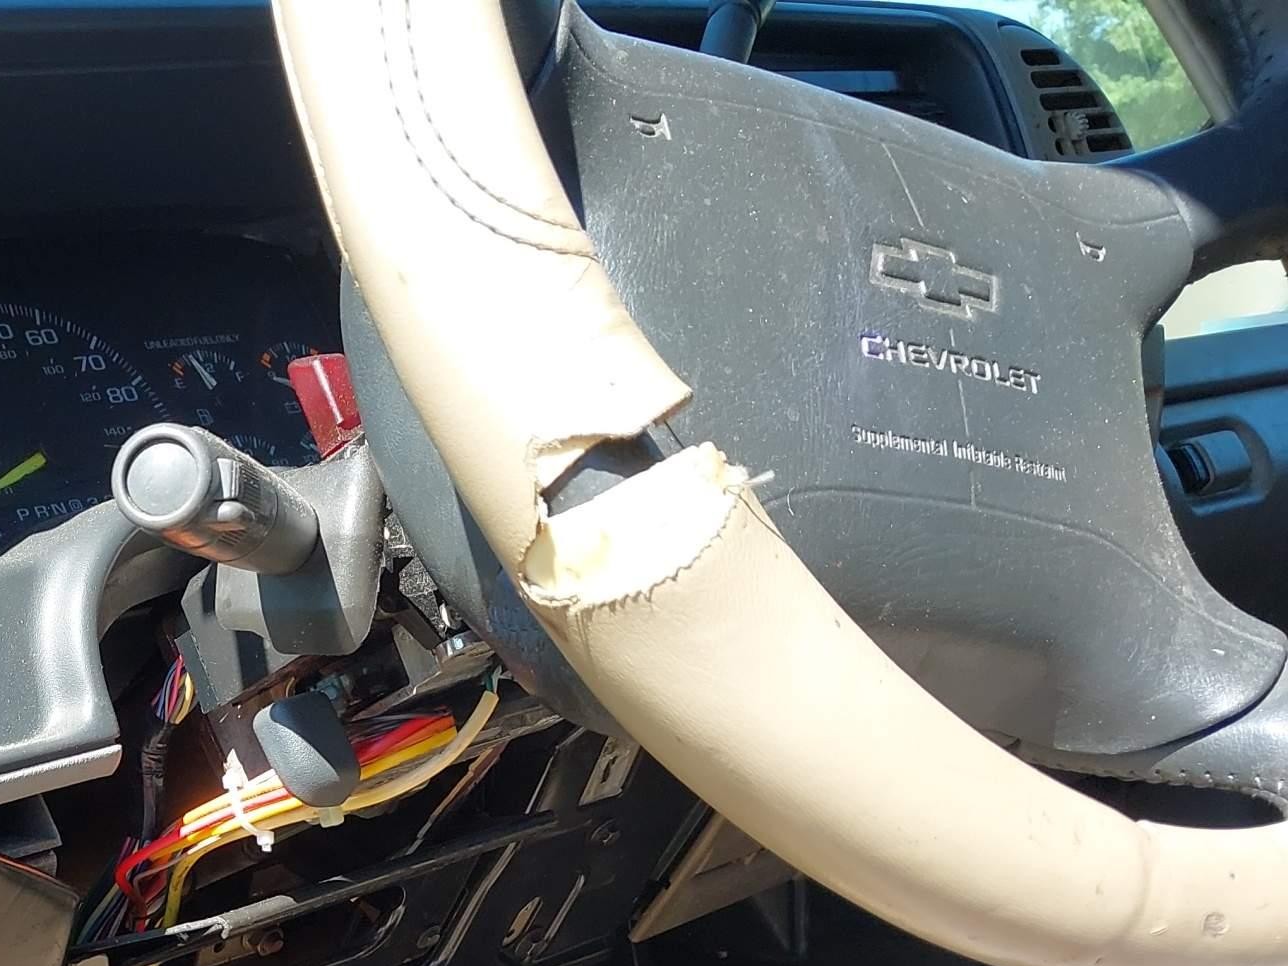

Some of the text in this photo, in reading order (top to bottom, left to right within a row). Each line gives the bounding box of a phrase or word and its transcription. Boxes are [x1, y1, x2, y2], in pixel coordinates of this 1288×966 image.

[25, 329, 59, 346] 60
[41, 364, 64, 376] 100
[72, 354, 106, 372] 70
[859, 335, 1041, 395] CHEVROLET
[174, 378, 186, 389] E
[235, 371, 245, 383] F
[106, 386, 139, 404] 80
[103, 426, 126, 437] 140
[851, 424, 948, 457] Supplemental
[952, 440, 1012, 470] Inflatable
[16, 508, 30, 521] P
[35, 505, 48, 519] R
[51, 502, 67, 515] N
